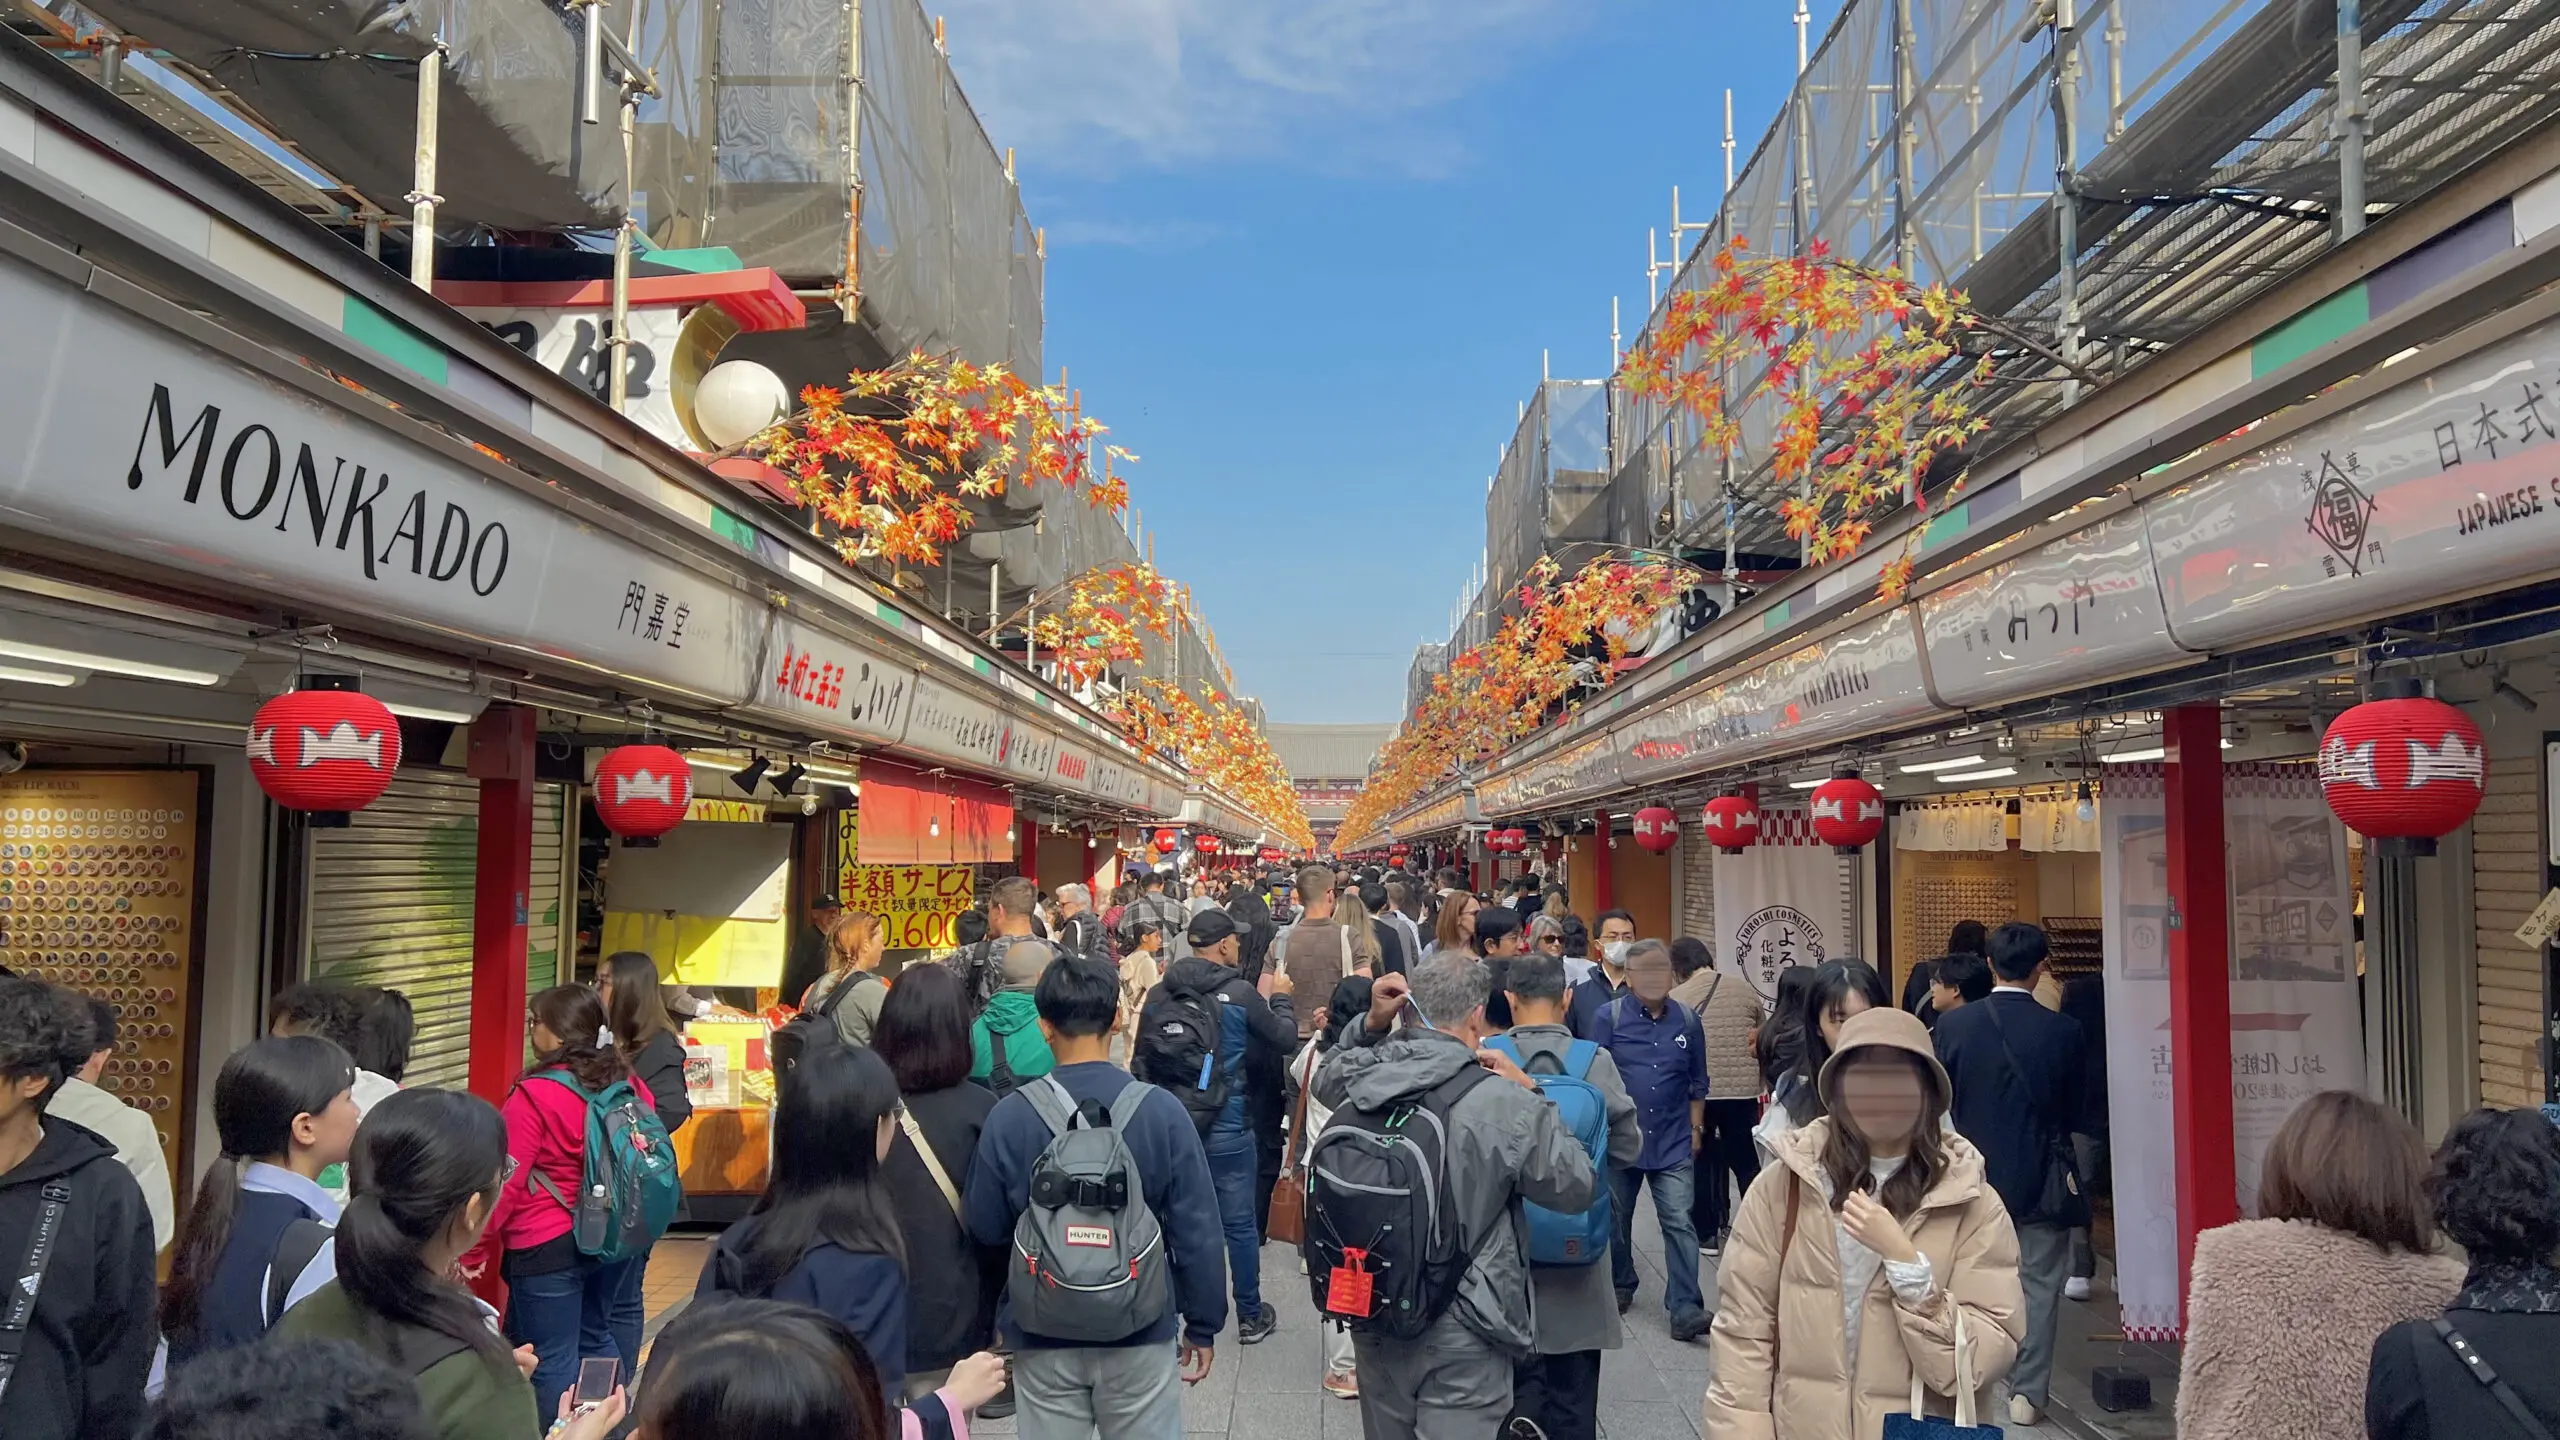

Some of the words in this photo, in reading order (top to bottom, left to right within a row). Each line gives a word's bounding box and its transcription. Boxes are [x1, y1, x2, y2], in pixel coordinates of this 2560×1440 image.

[2433, 371, 2560, 472] 日本式
[127, 381, 510, 598] MONKADO
[2458, 485, 2543, 535] JAPANESE
[617, 580, 690, 649] 門嘉堂
[1740, 911, 1774, 940] YOROSHI
[1776, 909, 1819, 940] COSMETICS
[1760, 940, 1776, 983] 化粧堂
[1070, 1230, 1108, 1241] HUNTER
